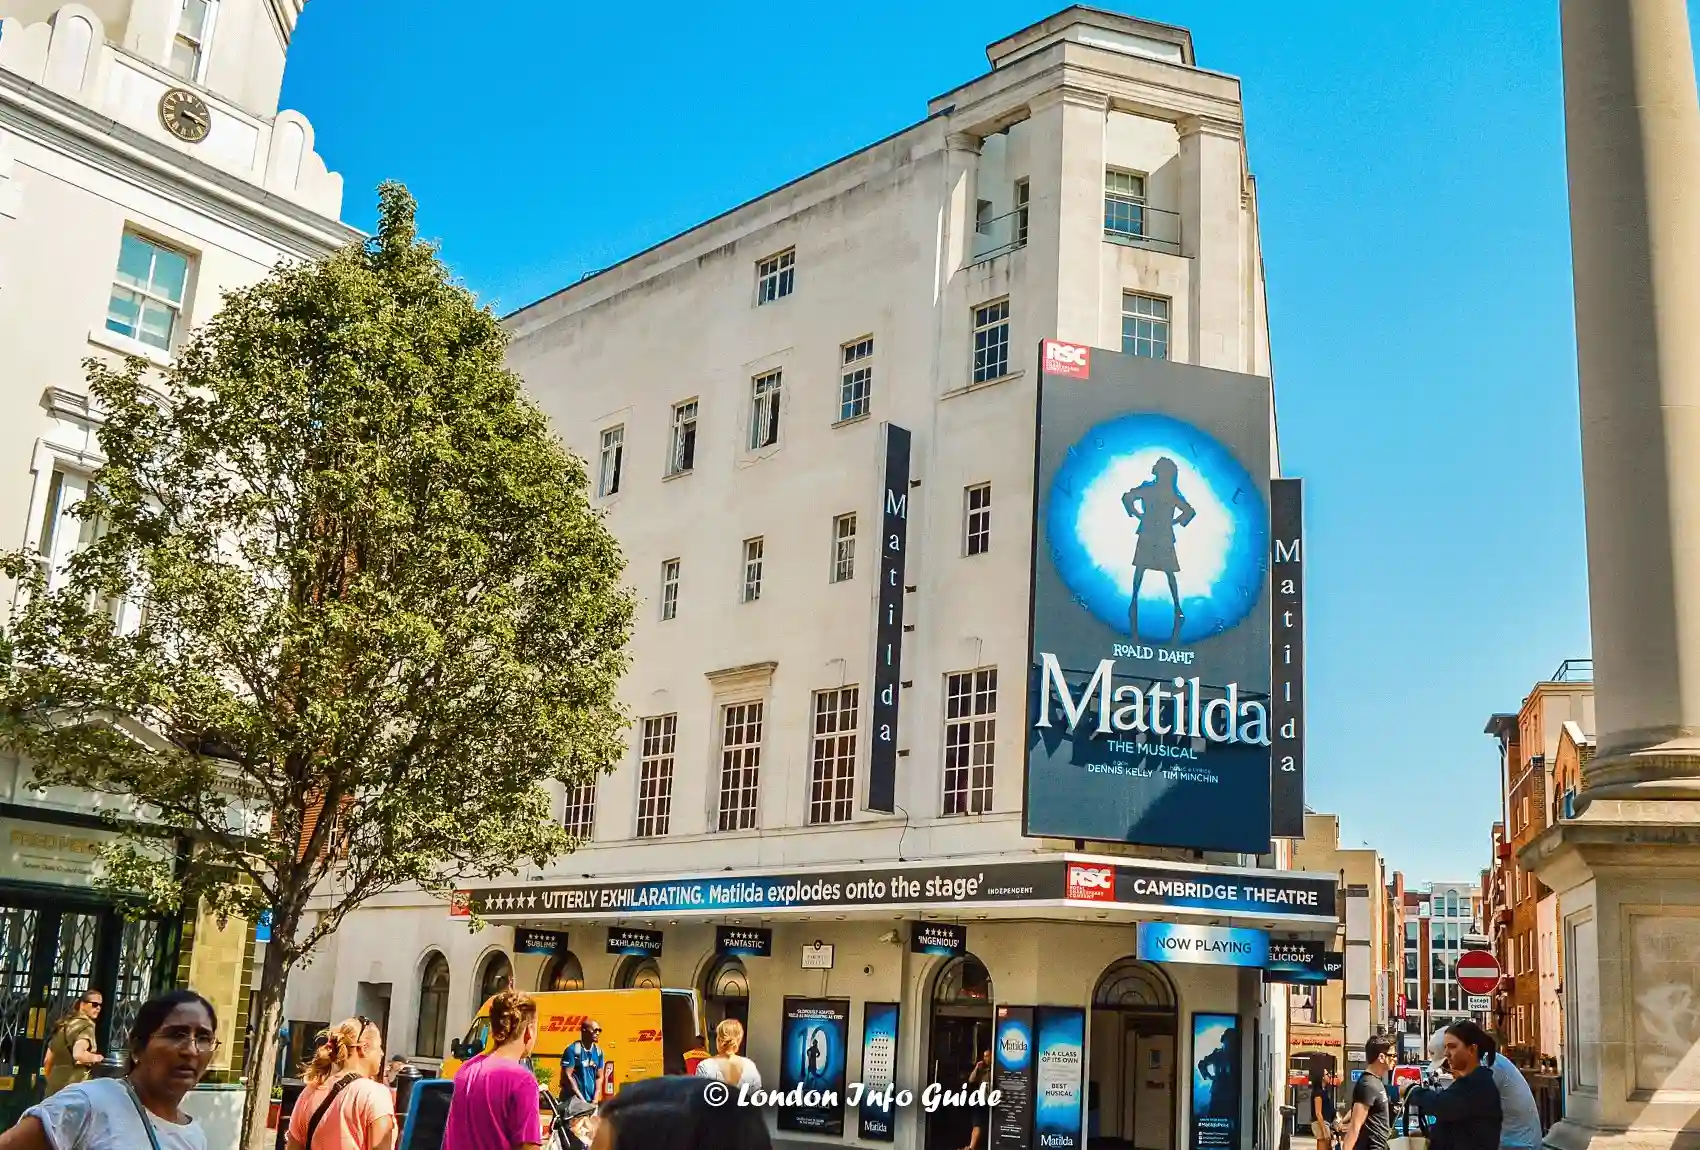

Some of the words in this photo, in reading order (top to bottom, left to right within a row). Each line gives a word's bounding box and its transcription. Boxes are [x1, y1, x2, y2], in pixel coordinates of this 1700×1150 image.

[1047, 342, 1086, 366] RSC
[879, 488, 907, 742] Matilda
[1113, 643, 1153, 659] ROALD
[1275, 539, 1301, 771] Matilda
[1035, 652, 1272, 747] Matilda
[1107, 740, 1134, 754] THE
[1137, 742, 1198, 760] MUSICAL
[1088, 764, 1123, 776] DENNIS
[1125, 766, 1153, 778] KELLY
[1162, 770, 1178, 780] TIM
[1180, 772, 1219, 783] MINCHIN
[1070, 866, 1111, 889] RSC
[709, 882, 763, 904] Matilda
[767, 879, 841, 905] explodes
[845, 879, 886, 899] onto
[890, 875, 921, 897] the
[925, 873, 984, 900] stage'
[987, 887, 1033, 895] INDEPENDENT
[1133, 879, 1238, 901] CAMBRIDGE
[1243, 886, 1318, 906] THEATRE
[1156, 937, 1191, 950] NOW
[1195, 939, 1252, 954] PLAYING
[1269, 953, 1314, 963] ELICIOUS'
[999, 1037, 1028, 1052] Matilda
[864, 1120, 887, 1133] Matilda
[1040, 1134, 1074, 1146] Matilda
